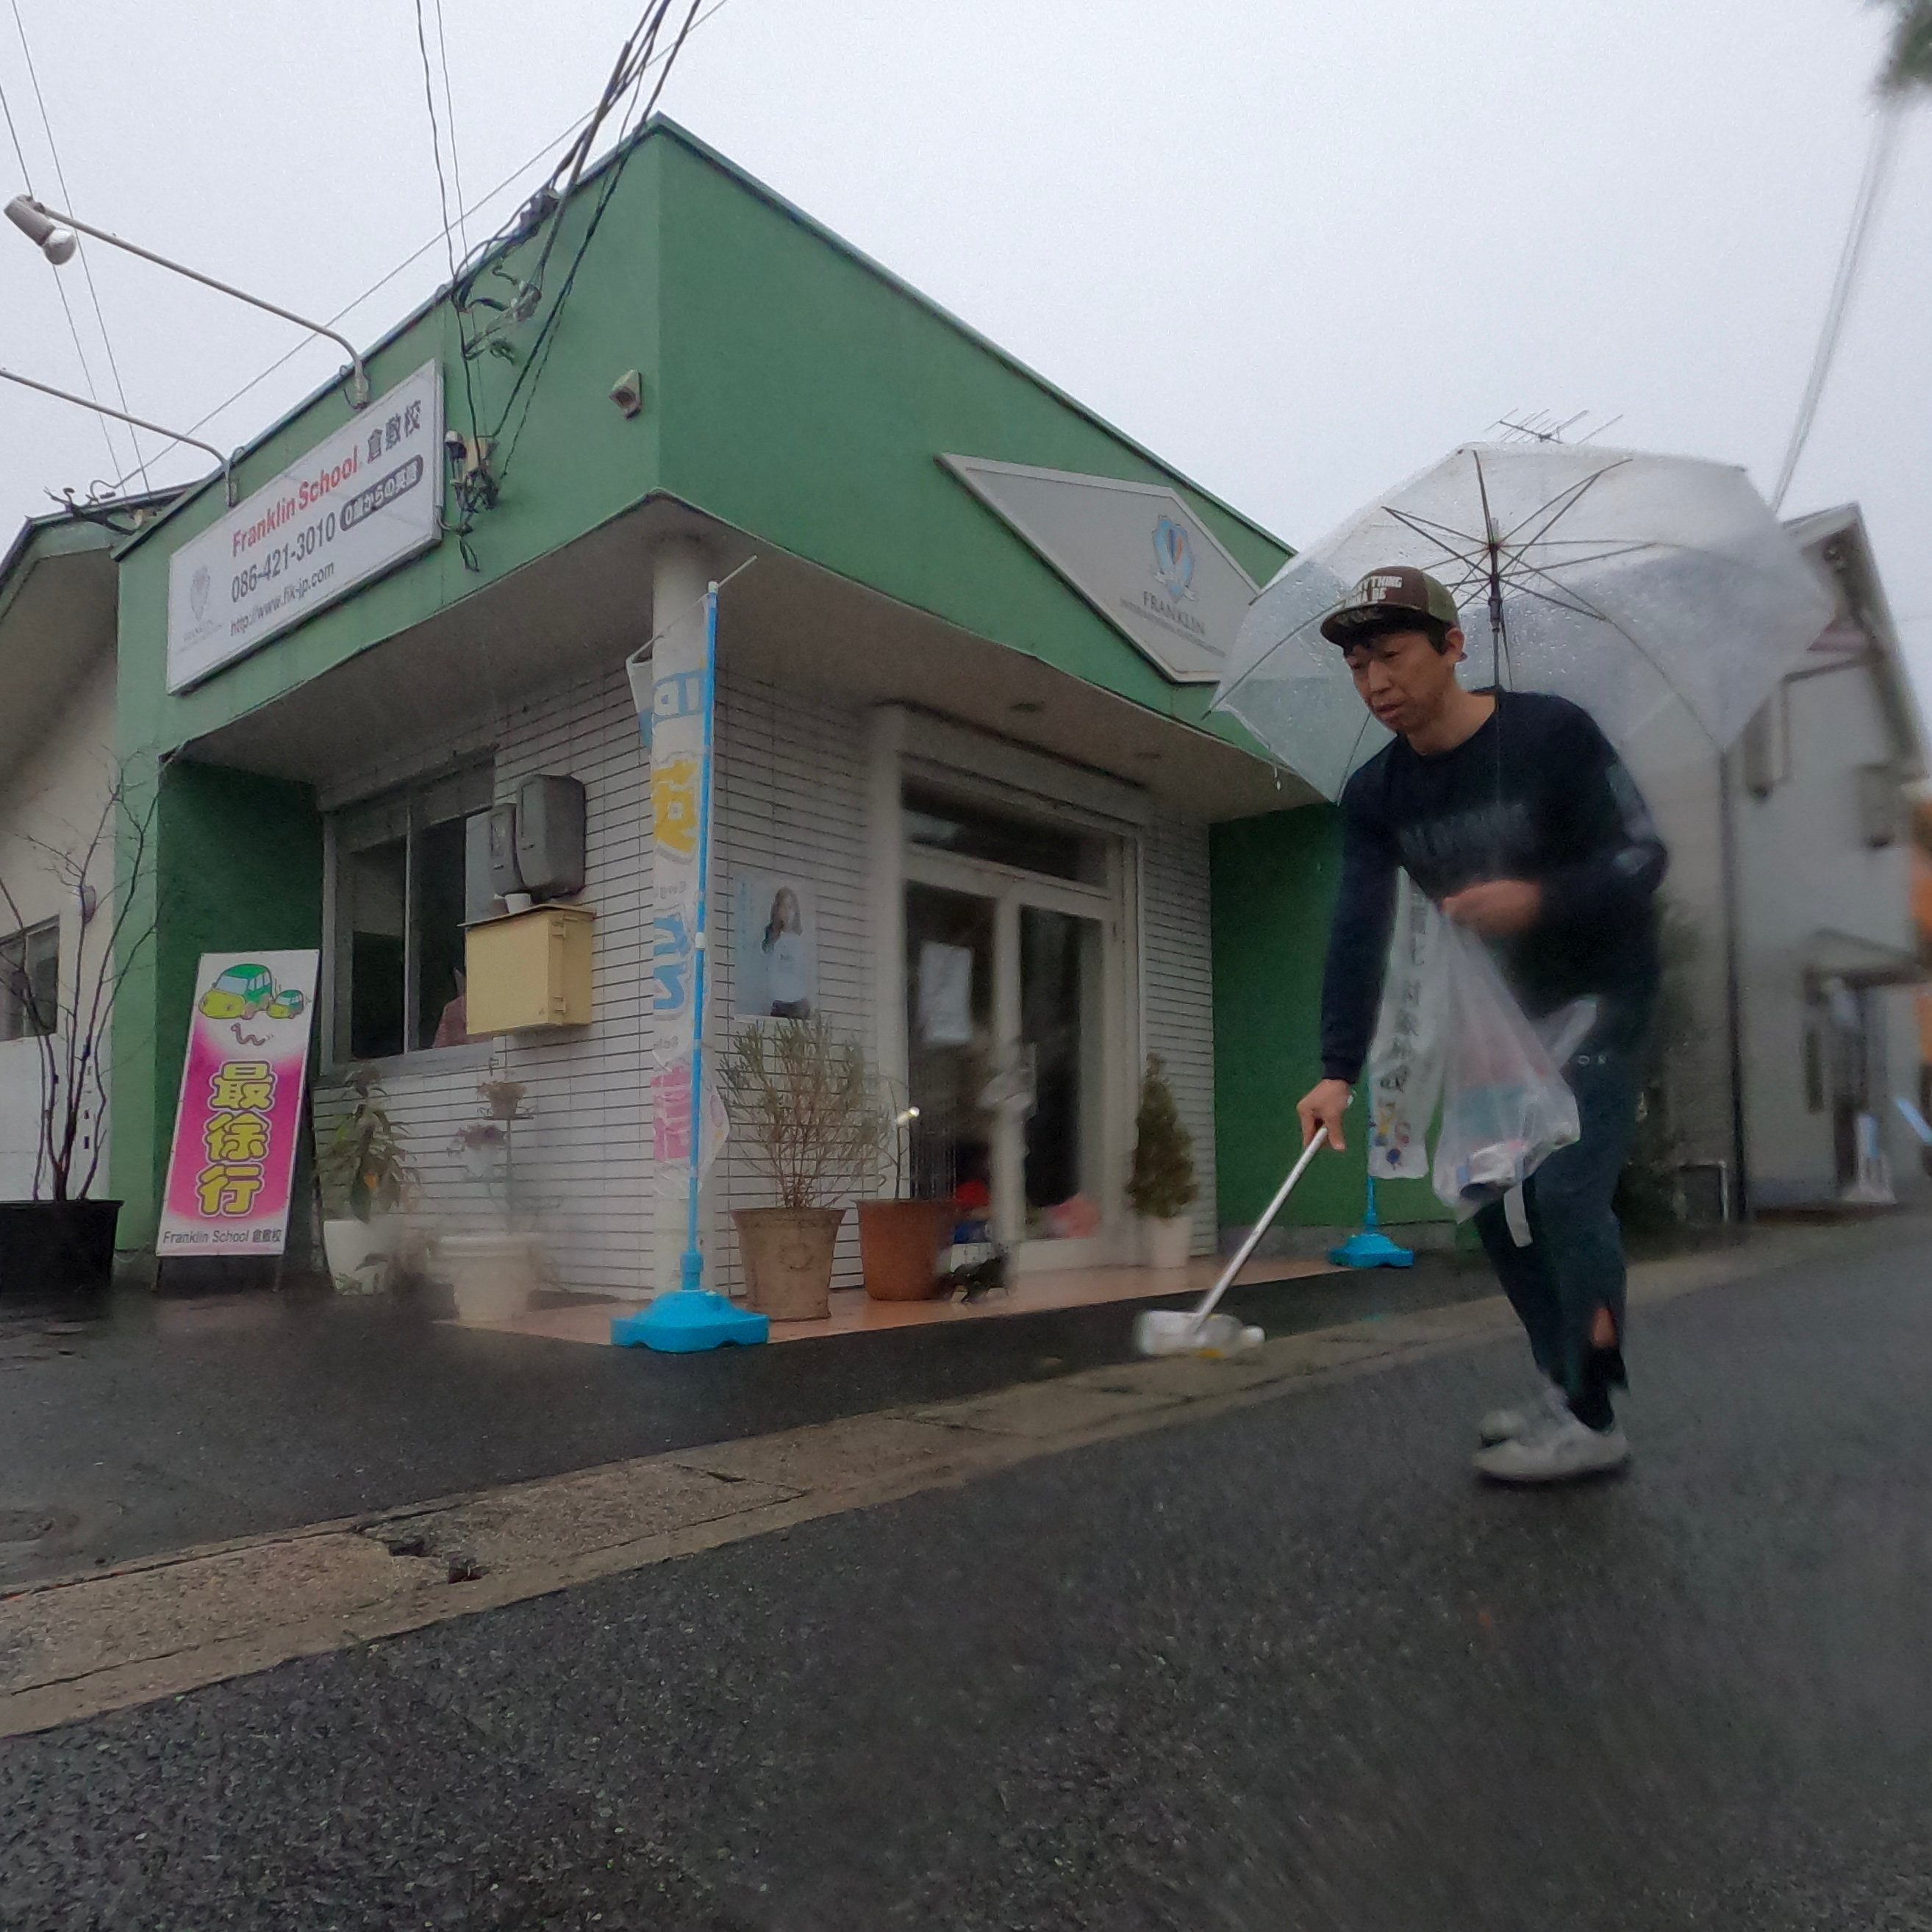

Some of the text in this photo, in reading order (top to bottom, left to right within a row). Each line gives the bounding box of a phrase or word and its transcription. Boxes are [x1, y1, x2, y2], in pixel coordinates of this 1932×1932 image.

[232, 497, 296, 557] Franklin
[298, 446, 358, 510] School
[231, 512, 336, 603] 086-421-3010
[198, 1060, 277, 1217] 最徐行
[163, 1231, 208, 1244] Franklin
[212, 1230, 250, 1242] School
